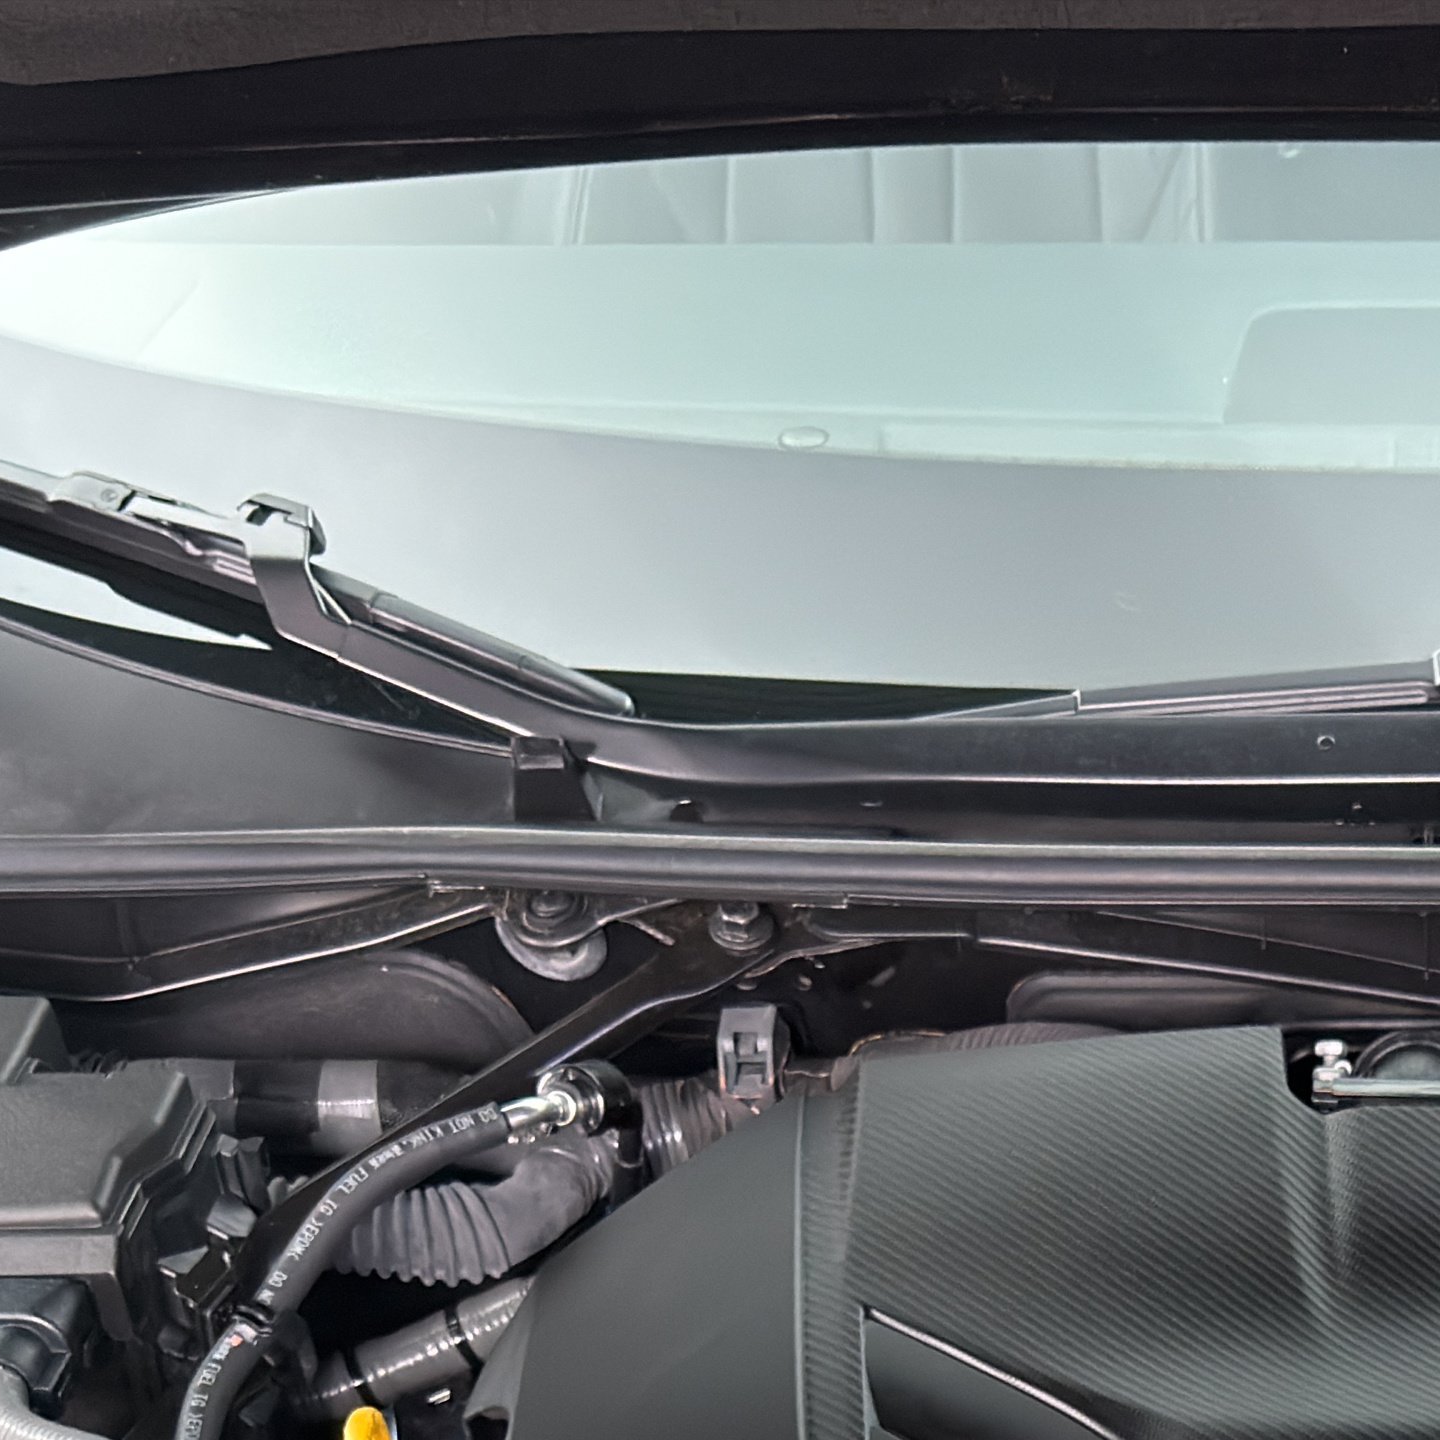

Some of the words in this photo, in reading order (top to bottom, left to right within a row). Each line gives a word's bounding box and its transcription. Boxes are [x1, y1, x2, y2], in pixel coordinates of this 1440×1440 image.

[449, 1115, 474, 1134] NOT
[337, 1167, 368, 1195] FUEL
[268, 1271, 288, 1288] DO
[199, 1363, 221, 1386] FUEL
